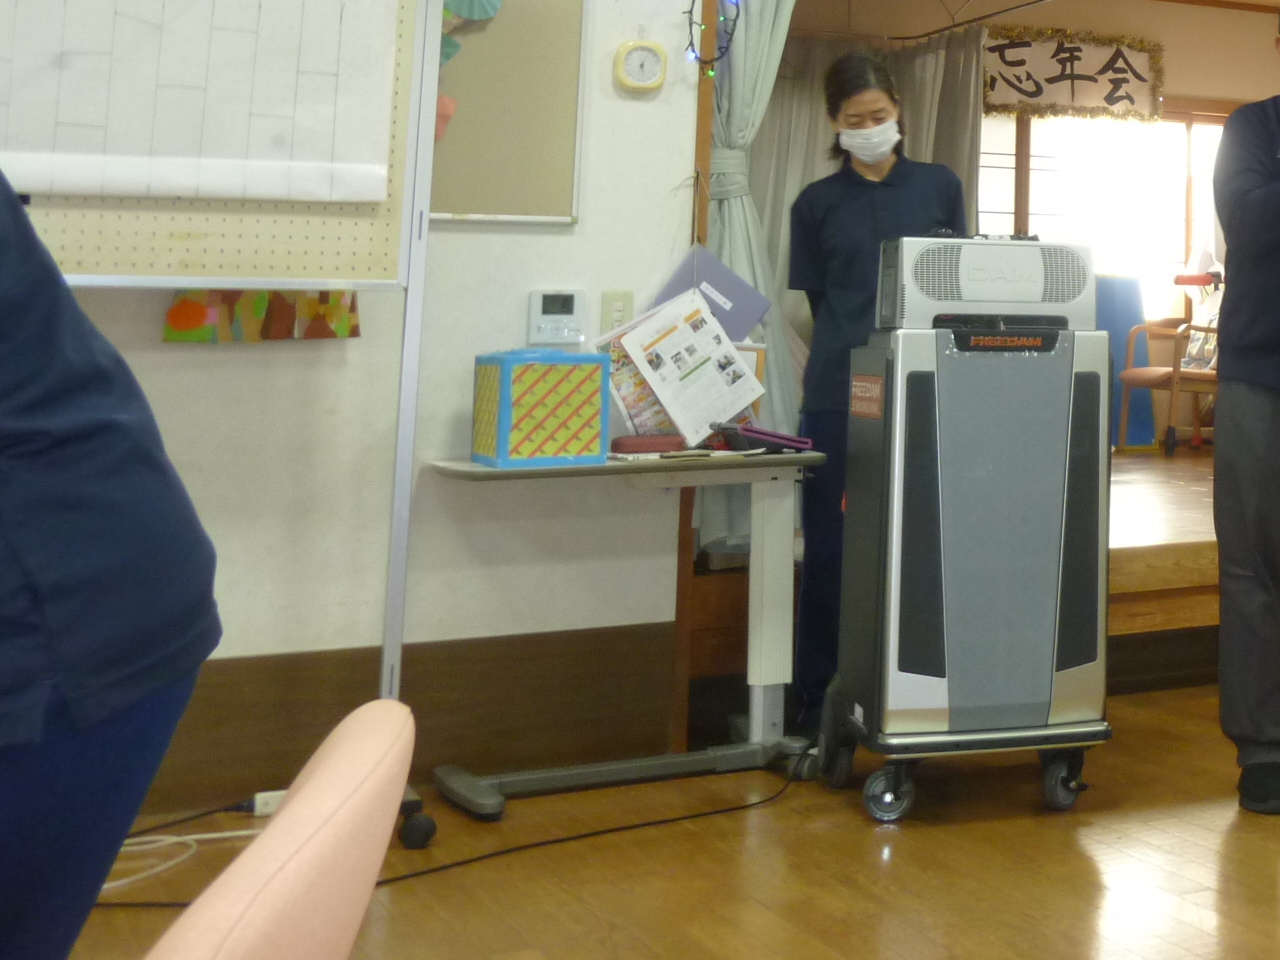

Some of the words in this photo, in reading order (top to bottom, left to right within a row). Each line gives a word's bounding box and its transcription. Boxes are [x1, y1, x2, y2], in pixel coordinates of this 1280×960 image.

[986, 38, 1149, 107] 忘年会
[966, 264, 1037, 283] DAM
[970, 335, 1042, 348] FREEDAM
